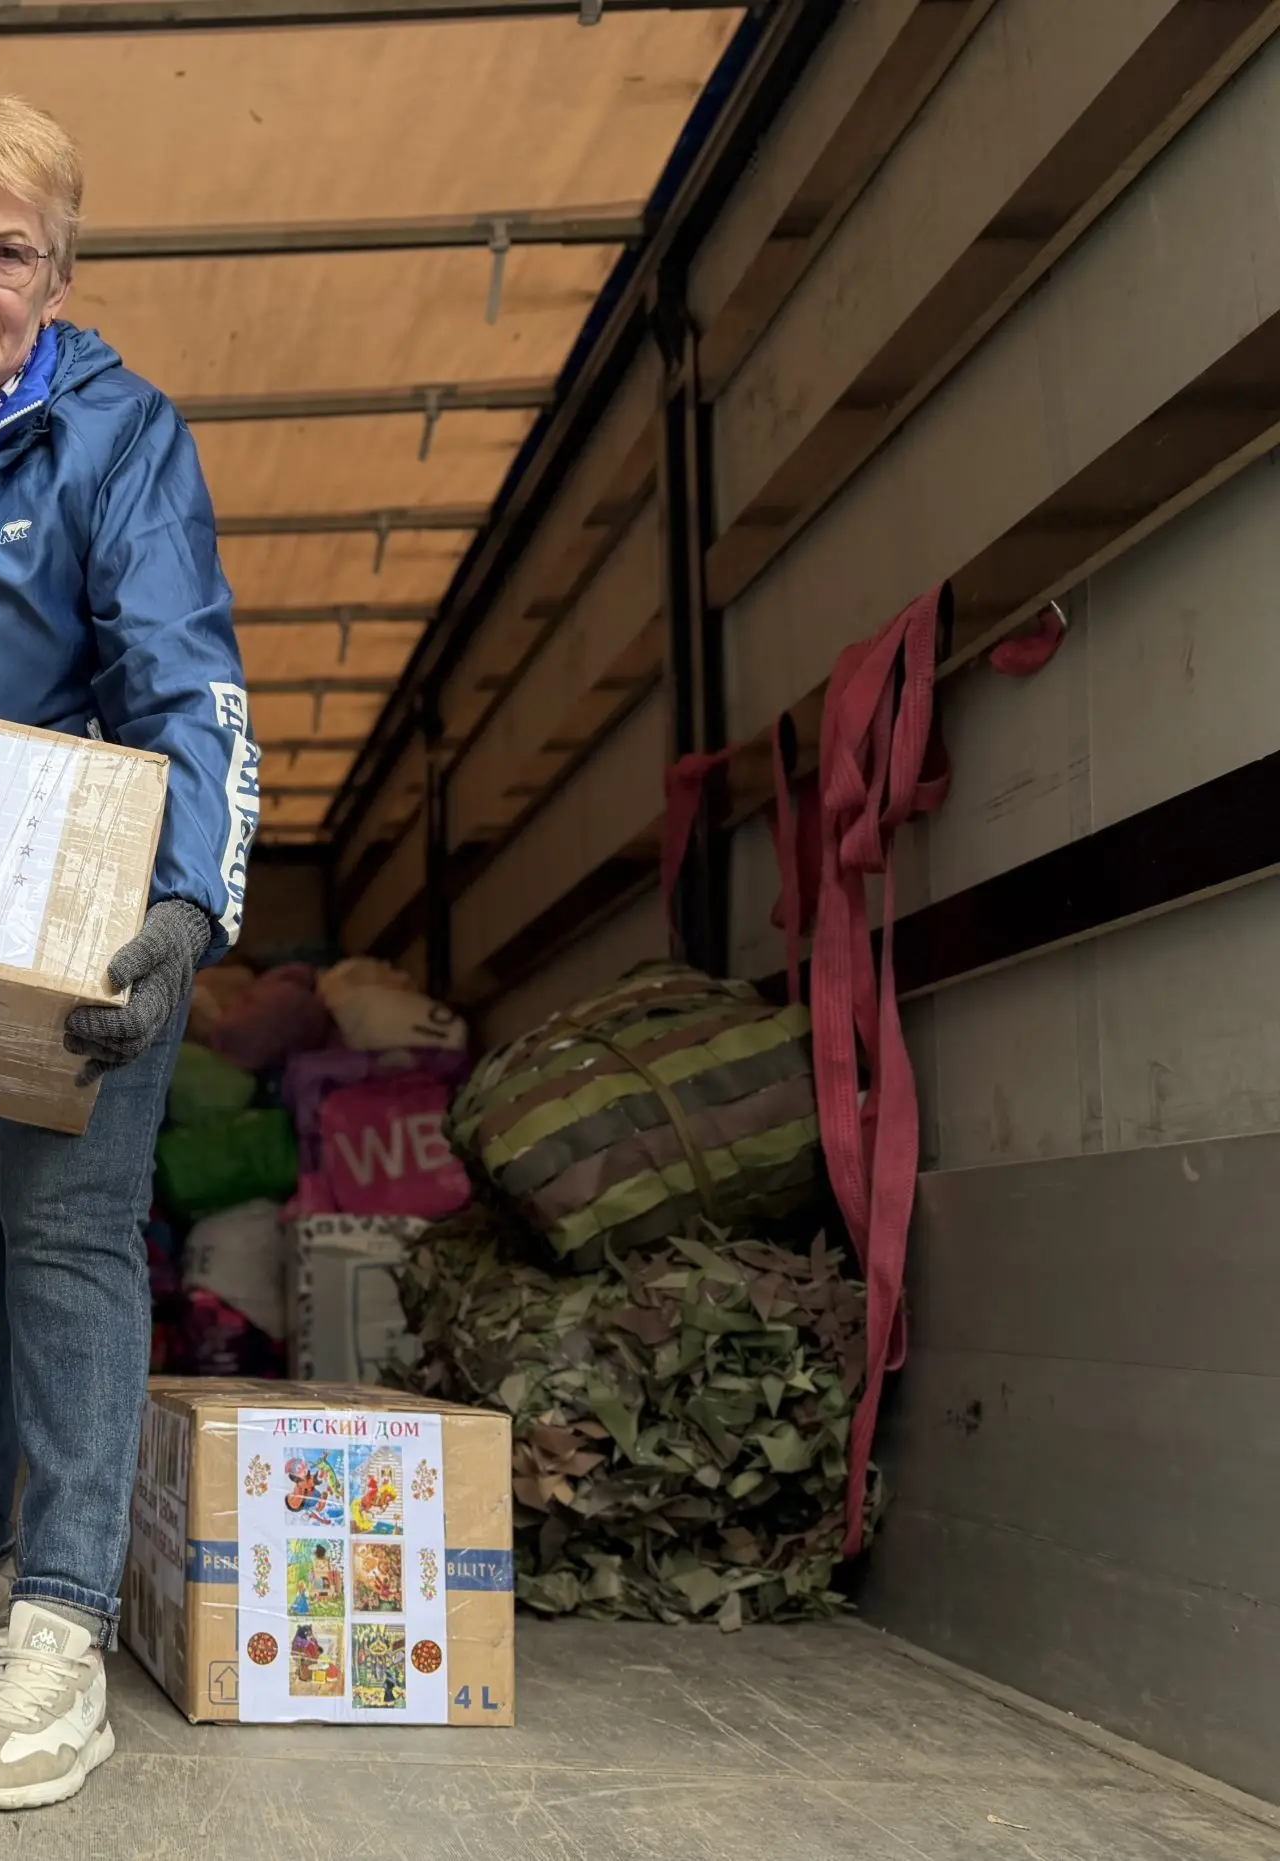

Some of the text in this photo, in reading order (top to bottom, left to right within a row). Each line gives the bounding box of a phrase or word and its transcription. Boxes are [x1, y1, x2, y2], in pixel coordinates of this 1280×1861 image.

[333, 1113, 454, 1188] WB
[273, 1415, 420, 1440] ДЕТСКИЙ ДОМ
[447, 1561, 496, 1577] BILITY
[454, 1685, 499, 1710] 4 L
